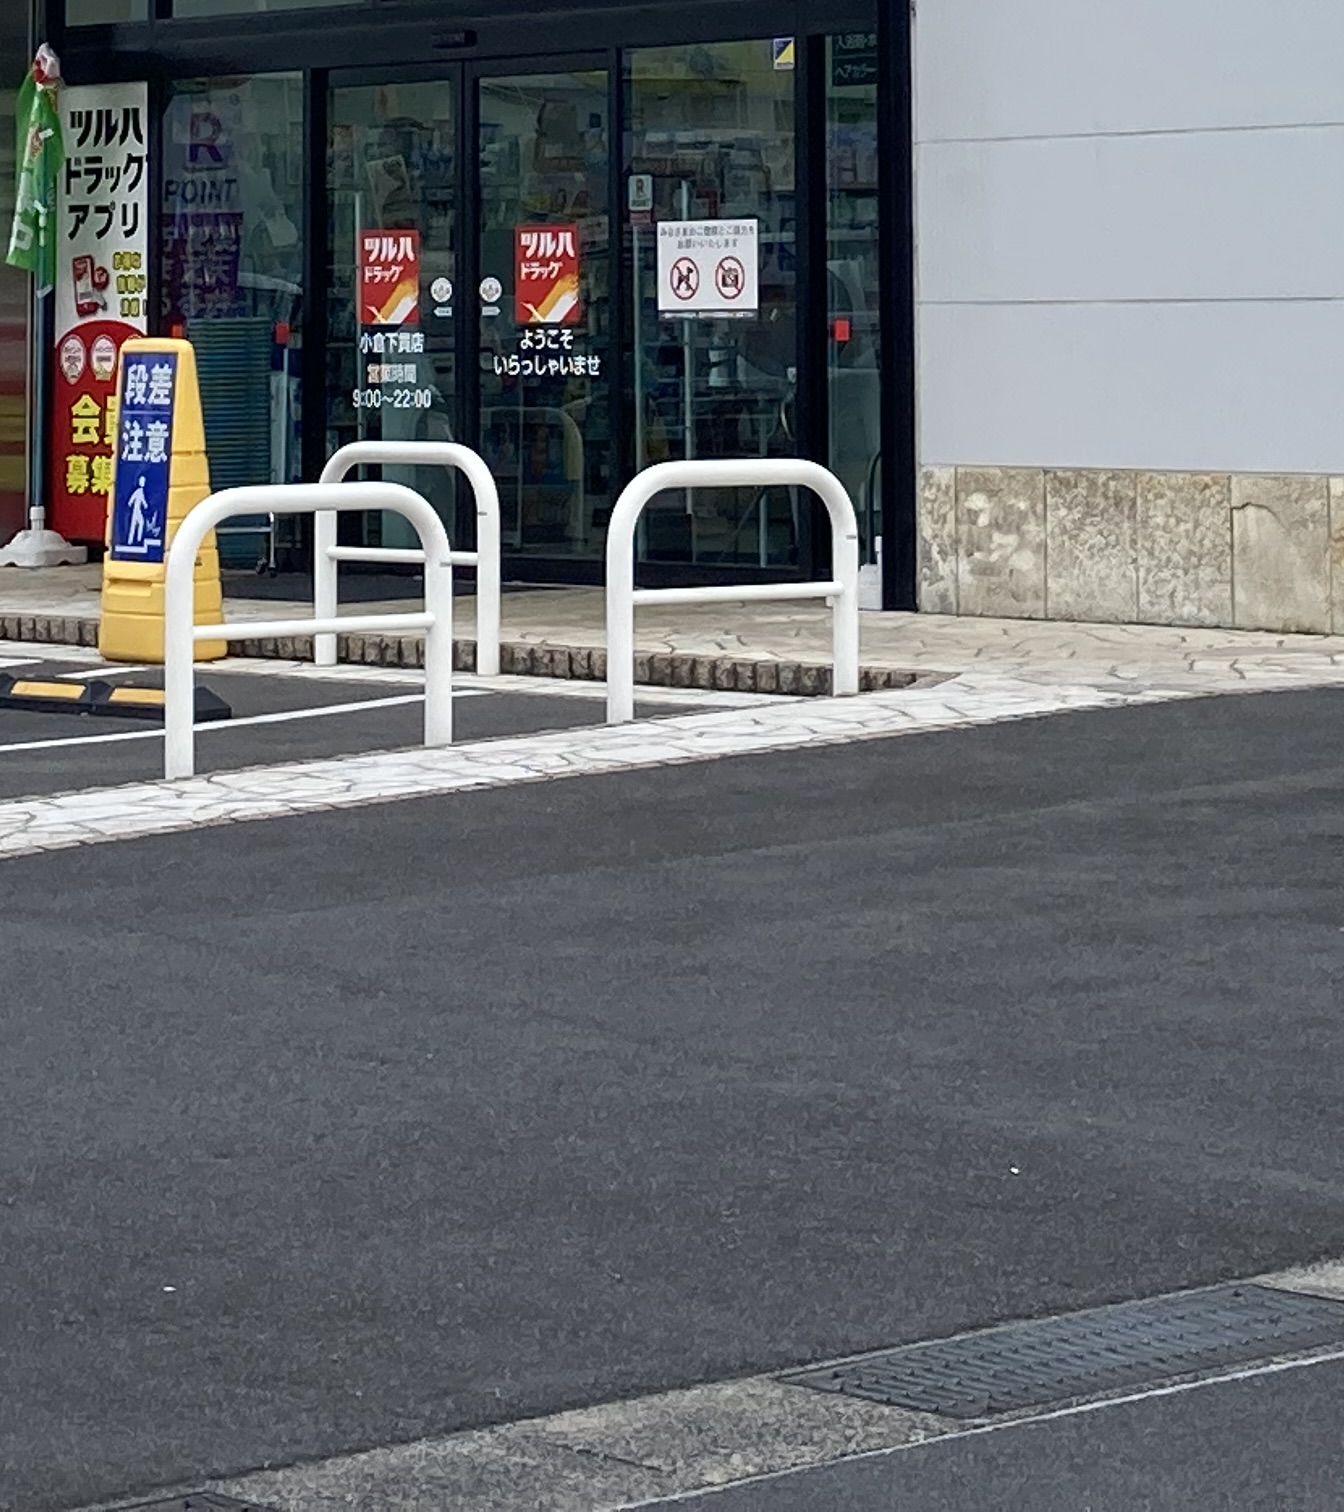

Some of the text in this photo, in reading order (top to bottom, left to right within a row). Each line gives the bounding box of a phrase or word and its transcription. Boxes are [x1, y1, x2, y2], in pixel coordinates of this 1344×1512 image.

[69, 107, 144, 148] ツルハ
[65, 152, 148, 195] ドラッグ
[164, 178, 237, 203] POINT
[67, 201, 139, 240] アプリ
[363, 236, 416, 263] ツルハ
[520, 232, 576, 258] ツルハ
[364, 265, 404, 283] ドラッグ
[520, 261, 563, 280] ドラッグ
[519, 329, 574, 351] ようこそ
[493, 355, 601, 376] いらっしゃいませ
[124, 363, 173, 406] 段差
[121, 419, 169, 463] 注意
